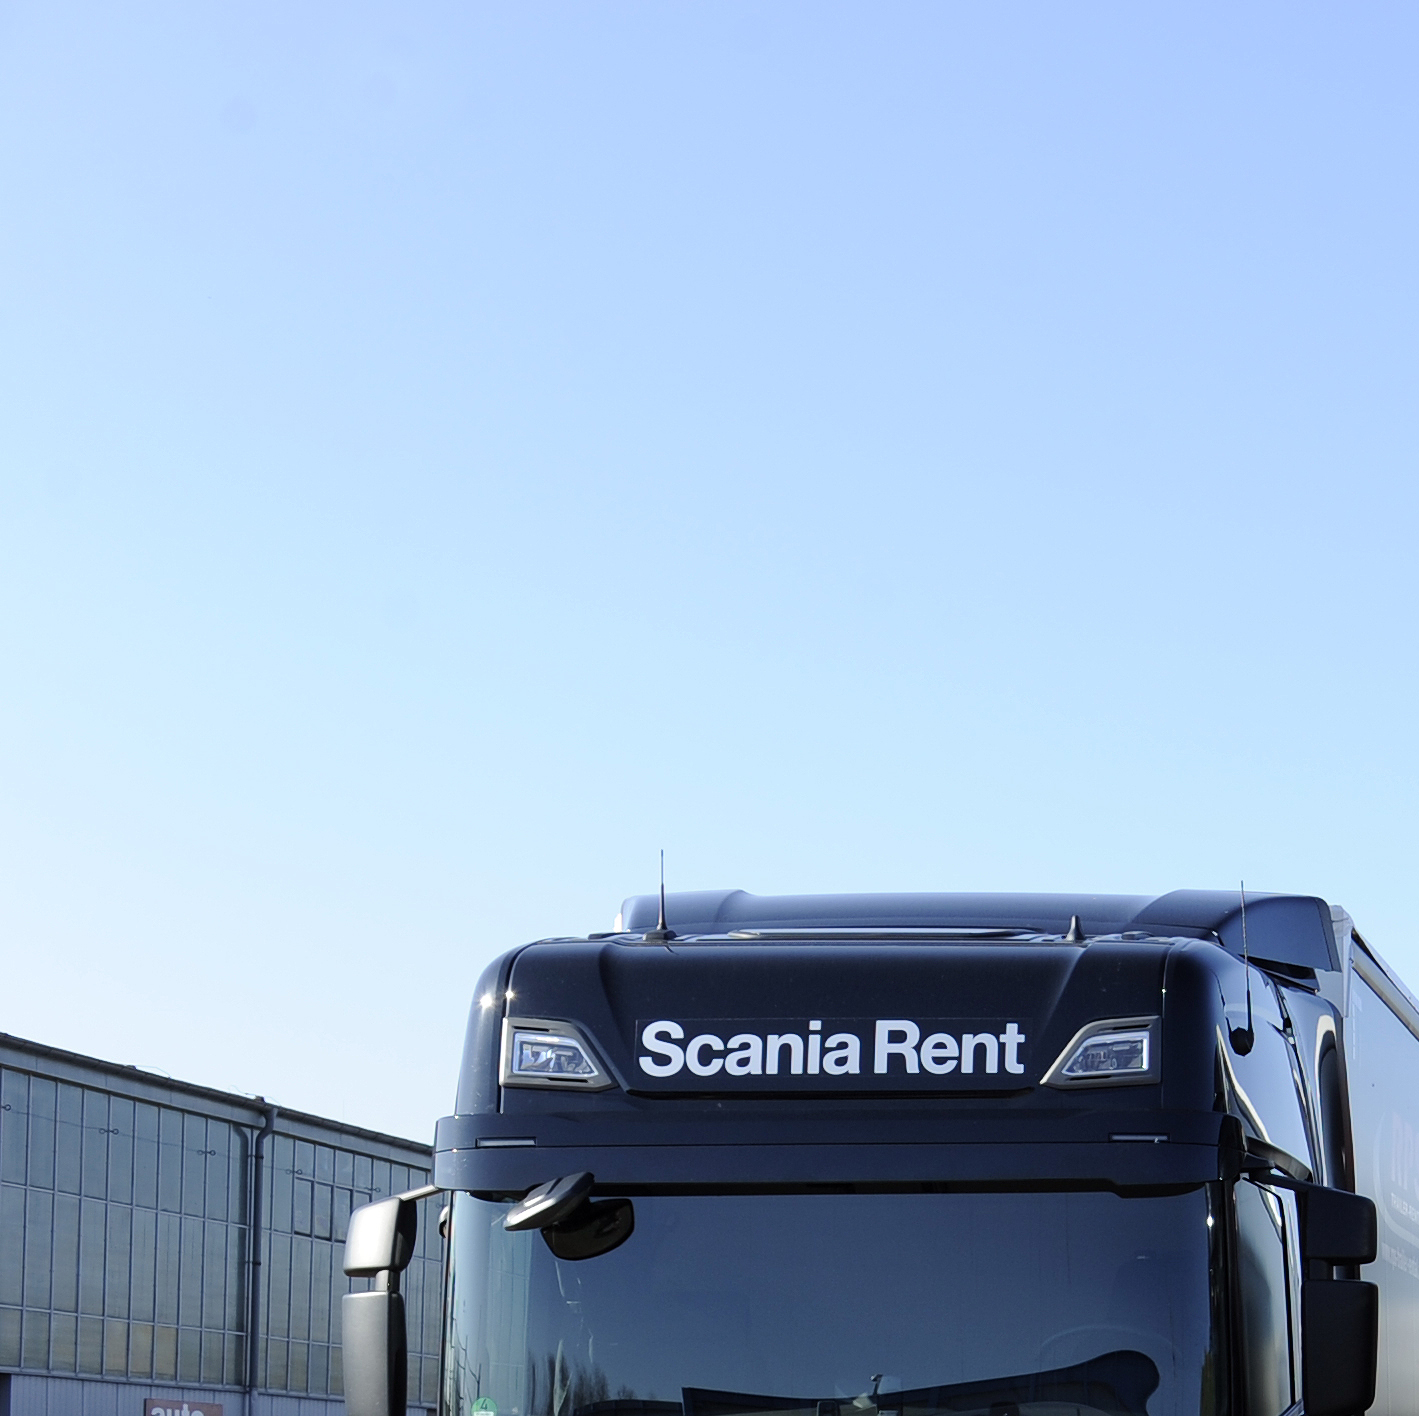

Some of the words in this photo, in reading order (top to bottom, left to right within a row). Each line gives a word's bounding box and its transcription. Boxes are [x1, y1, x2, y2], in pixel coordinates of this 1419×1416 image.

[638, 1020, 860, 1077] Scania
[874, 1020, 1025, 1075] Rent
[480, 1397, 488, 1411] 4
